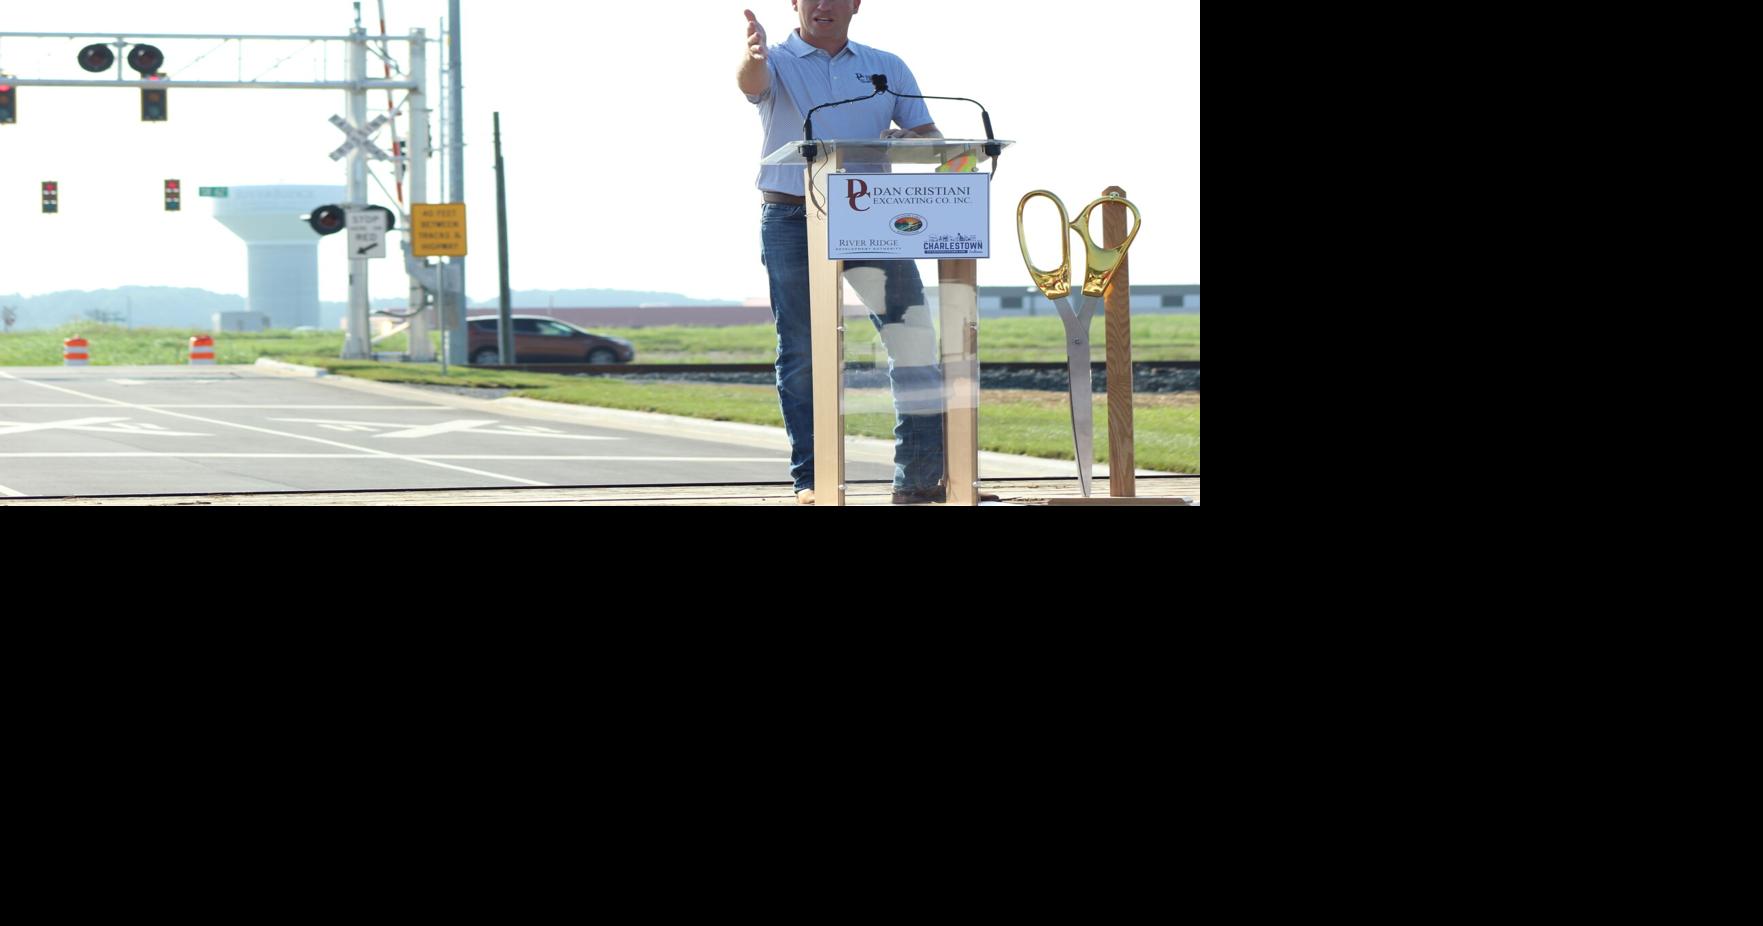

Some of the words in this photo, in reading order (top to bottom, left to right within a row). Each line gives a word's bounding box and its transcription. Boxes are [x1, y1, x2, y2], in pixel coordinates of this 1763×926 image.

[873, 187, 901, 196] DAN
[905, 186, 970, 196] CRISTIANI
[352, 215, 379, 223] STOP
[356, 233, 378, 241] RED
[839, 239, 867, 247] RIVER
[869, 239, 899, 247] RIDGE
[923, 242, 983, 250] CHARLESTOWN
